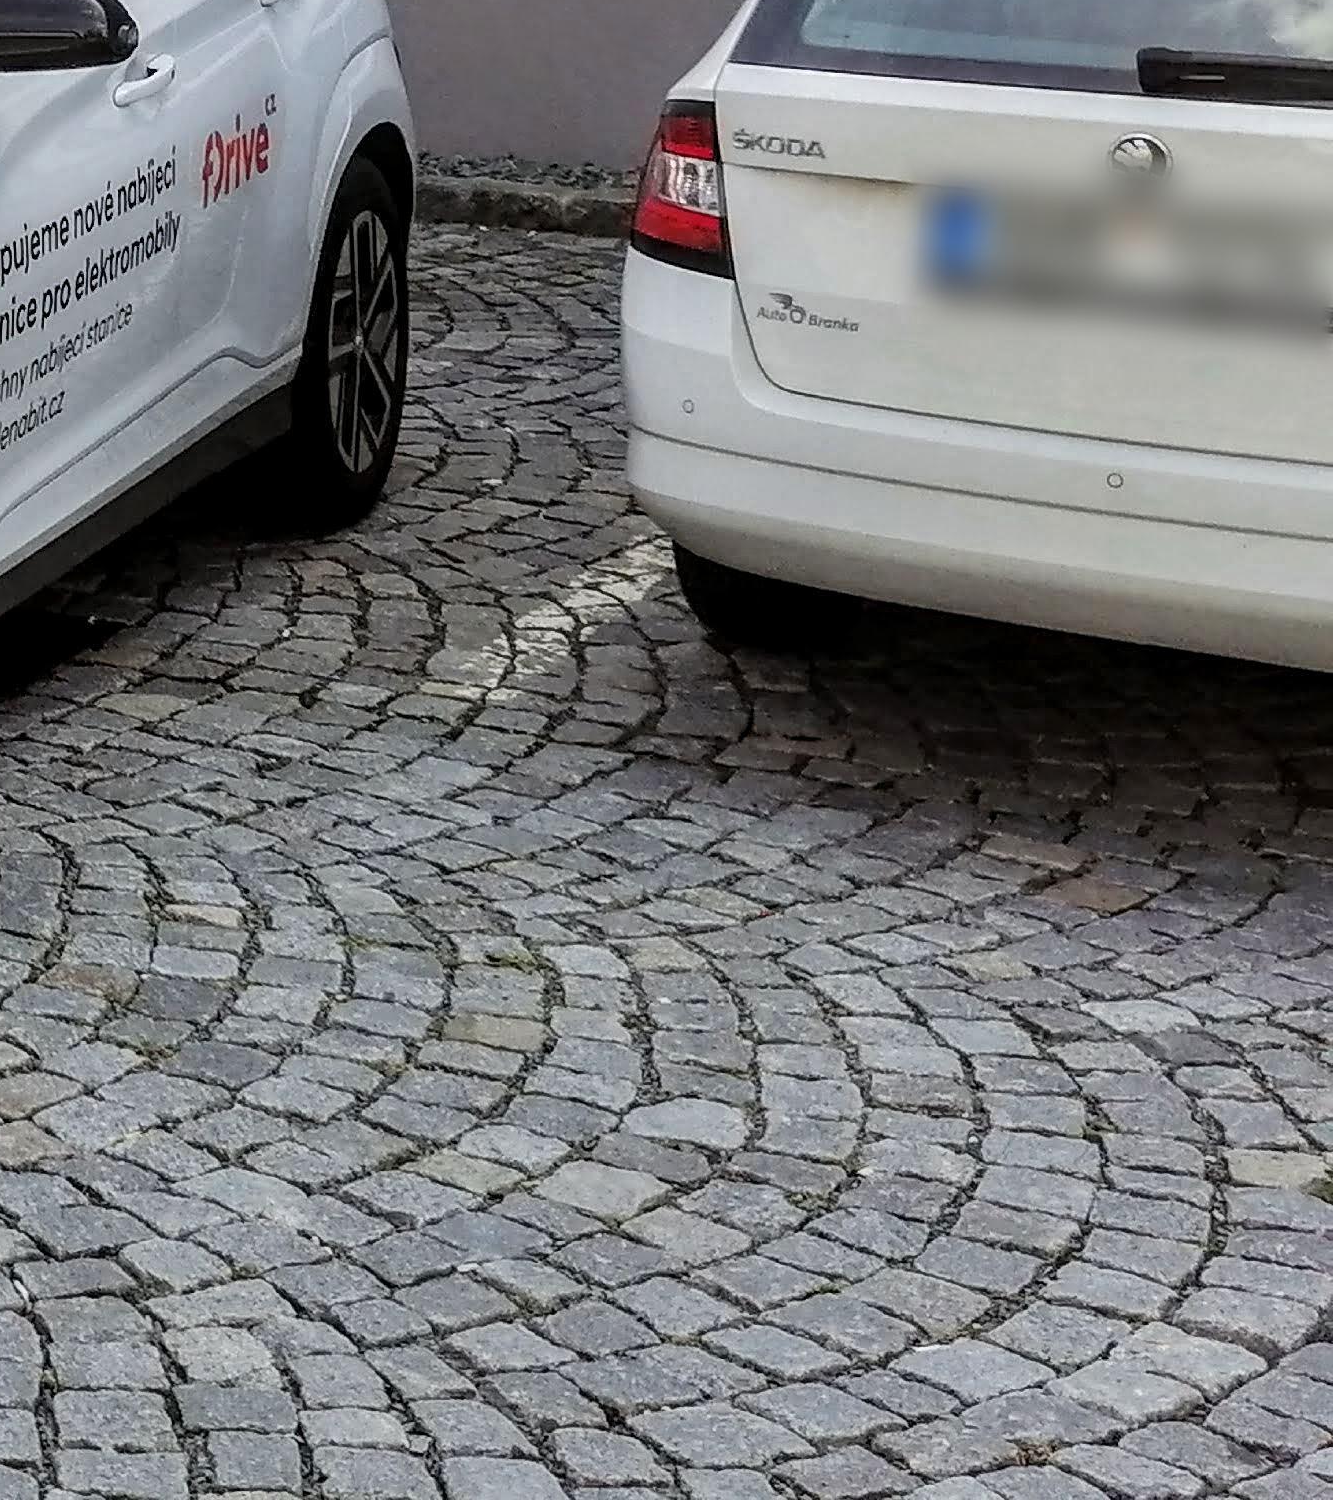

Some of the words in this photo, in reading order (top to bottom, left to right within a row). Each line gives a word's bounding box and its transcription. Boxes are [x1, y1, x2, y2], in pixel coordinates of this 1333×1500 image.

[733, 129, 826, 159] ŠKODA
[73, 181, 114, 236] nové
[117, 146, 177, 216] nabíjecí
[41, 278, 72, 330] pro
[75, 214, 180, 301] elektromobily
[86, 302, 133, 349] stanice
[756, 306, 788, 322] Auto
[808, 314, 859, 332] Branka
